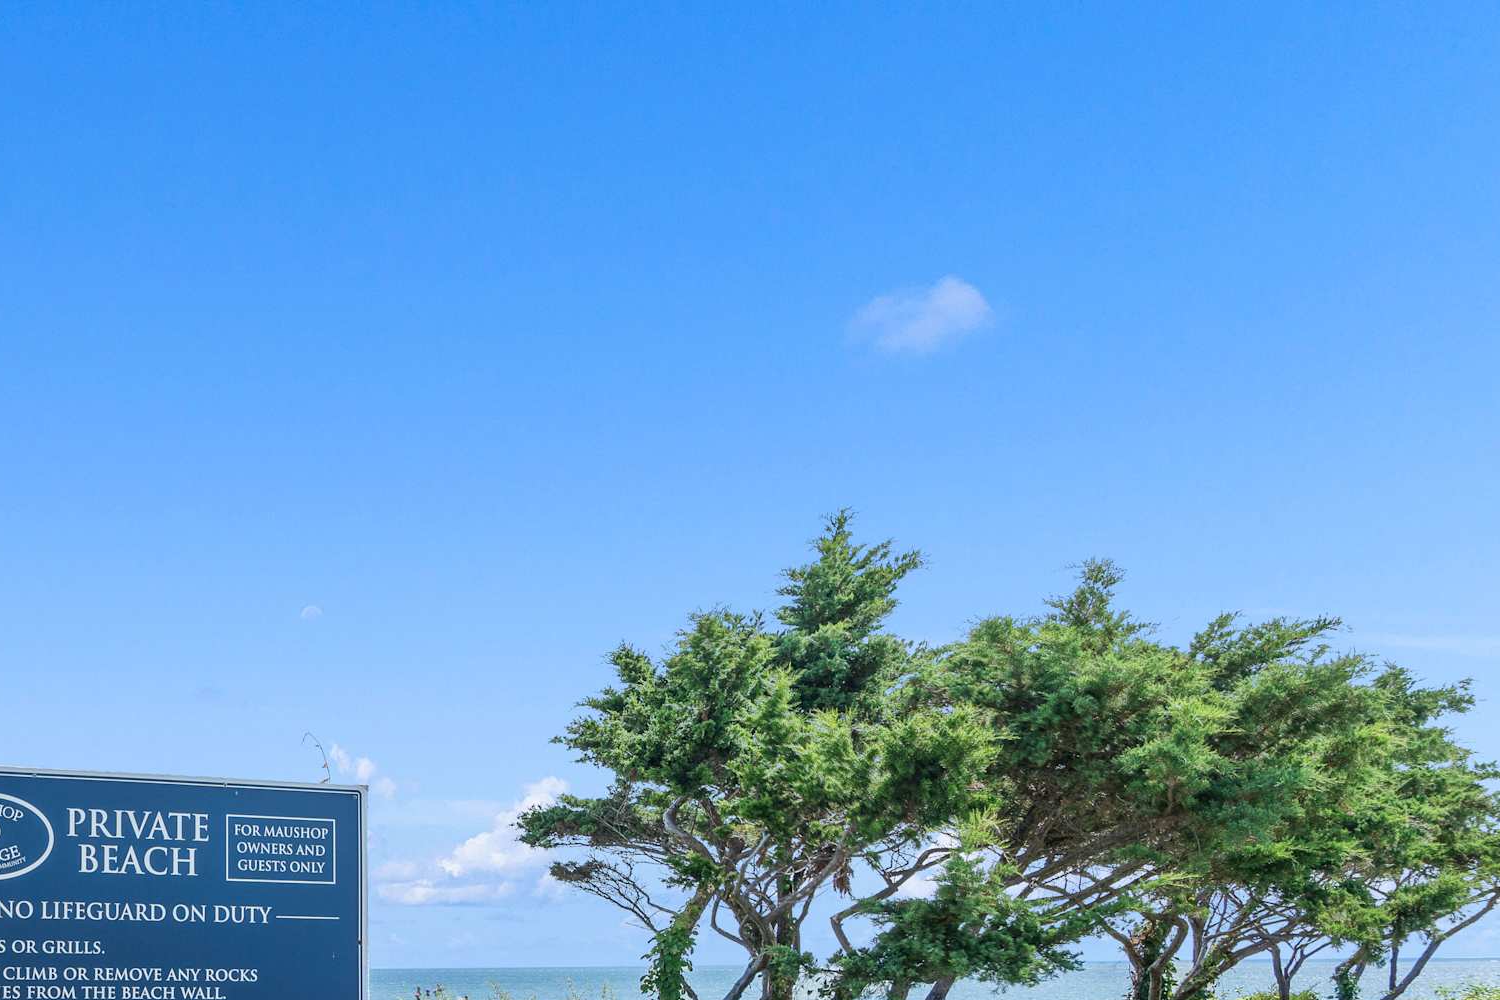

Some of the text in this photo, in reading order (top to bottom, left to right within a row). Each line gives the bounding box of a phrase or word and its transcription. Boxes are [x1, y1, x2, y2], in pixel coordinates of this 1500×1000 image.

[66, 807, 210, 843] PRIVATE
[234, 823, 329, 840] FOR MAUSHOP
[236, 841, 326, 857] OWNERS AND
[77, 843, 199, 877] BEACH
[237, 858, 326, 874] GUESTS ONLY
[41, 900, 167, 922] LIFEGUARD
[172, 903, 207, 923] ON
[213, 905, 273, 924] DUTY
[11, 939, 39, 954] OR
[41, 939, 106, 955] GRILLS.
[2, 966, 58, 981] CLIMB
[62, 966, 90, 981] OR
[93, 967, 163, 982] REMOVE
[165, 967, 202, 982] ANY
[204, 968, 258, 983] ROCKS
[27, 985, 77, 1000] FROM
[80, 985, 117, 1000] THE
[121, 985, 176, 1000] BEACH
[179, 986, 227, 1000] WALL.
